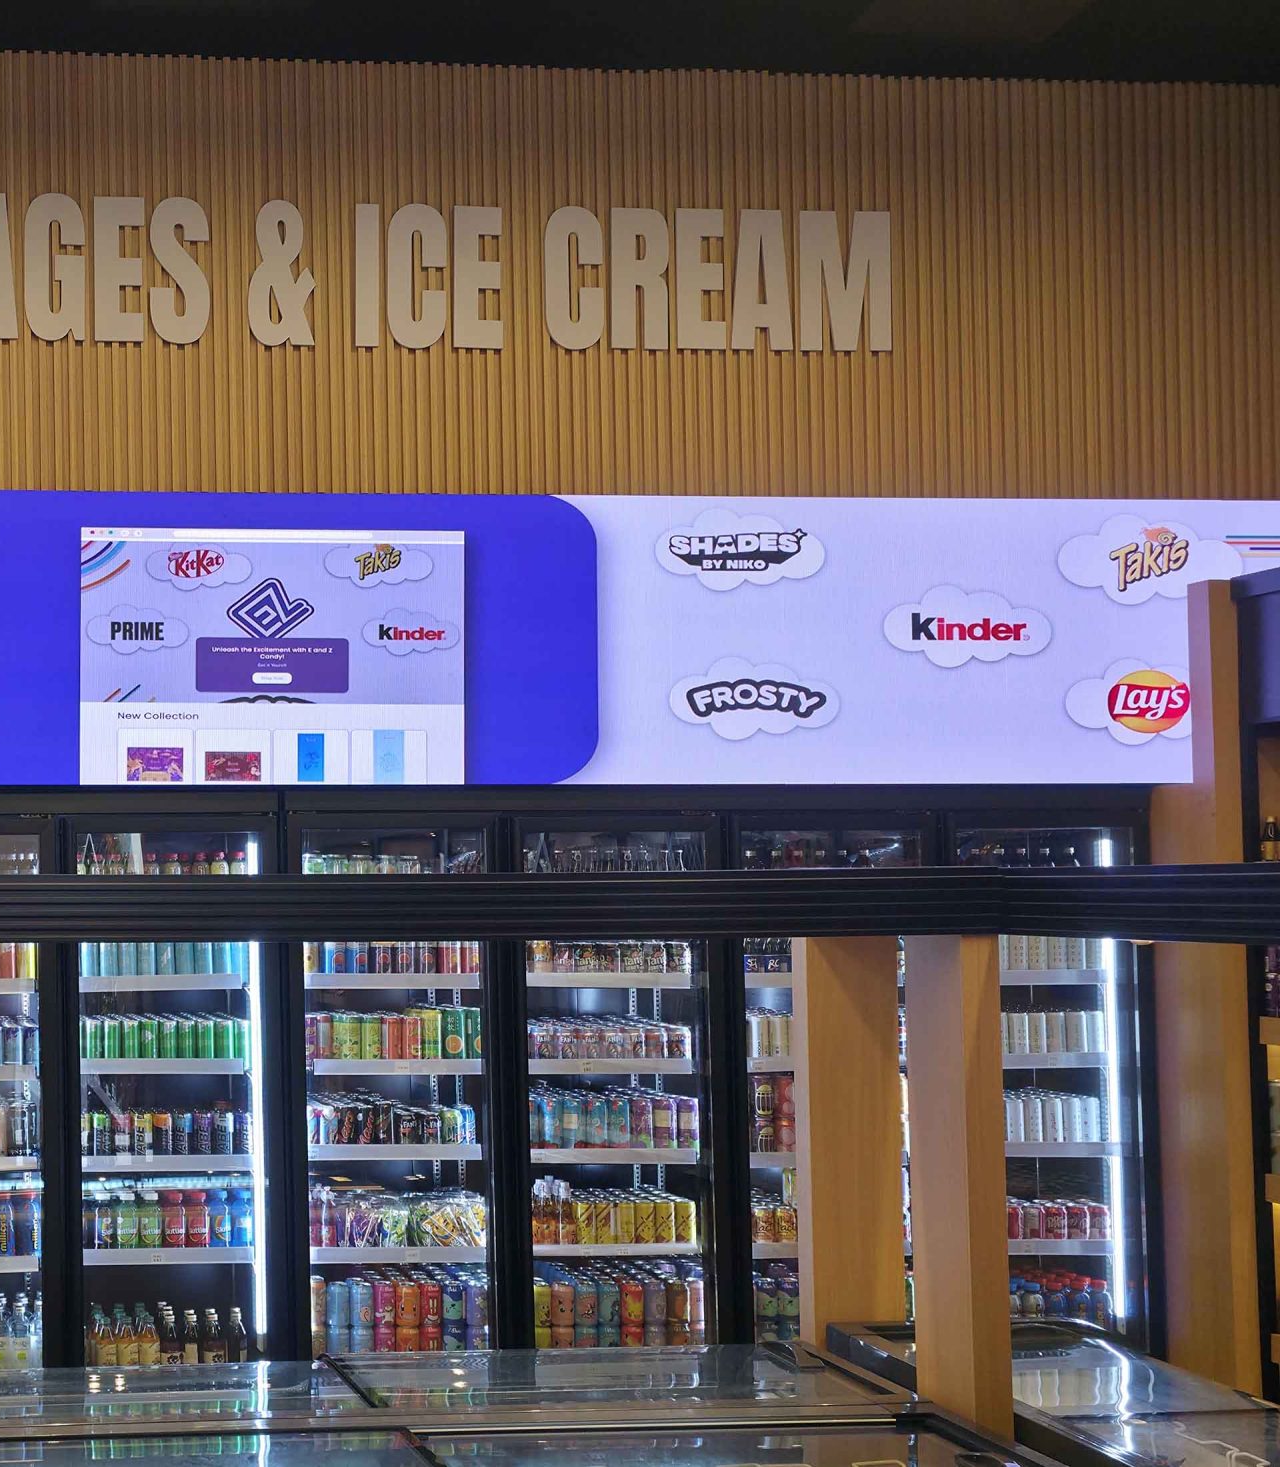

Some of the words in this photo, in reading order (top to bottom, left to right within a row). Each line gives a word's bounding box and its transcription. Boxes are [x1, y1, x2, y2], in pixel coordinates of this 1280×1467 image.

[247, 199, 316, 347] &
[356, 203, 503, 349] ICE
[544, 206, 892, 352] CREAM
[670, 532, 800, 556] SHADES
[173, 550, 222, 578] KitKat
[355, 549, 401, 580] Takis
[702, 560, 723, 569] BY
[726, 560, 766, 569] NIKO
[1110, 535, 1189, 592] Takis
[110, 621, 165, 642] PRIME
[696, 680, 820, 716] FROSTY
[1114, 683, 1185, 720] Lay's
[117, 712, 141, 720] New
[144, 712, 199, 720] Collection
[0, 1214, 7, 1252] millions
